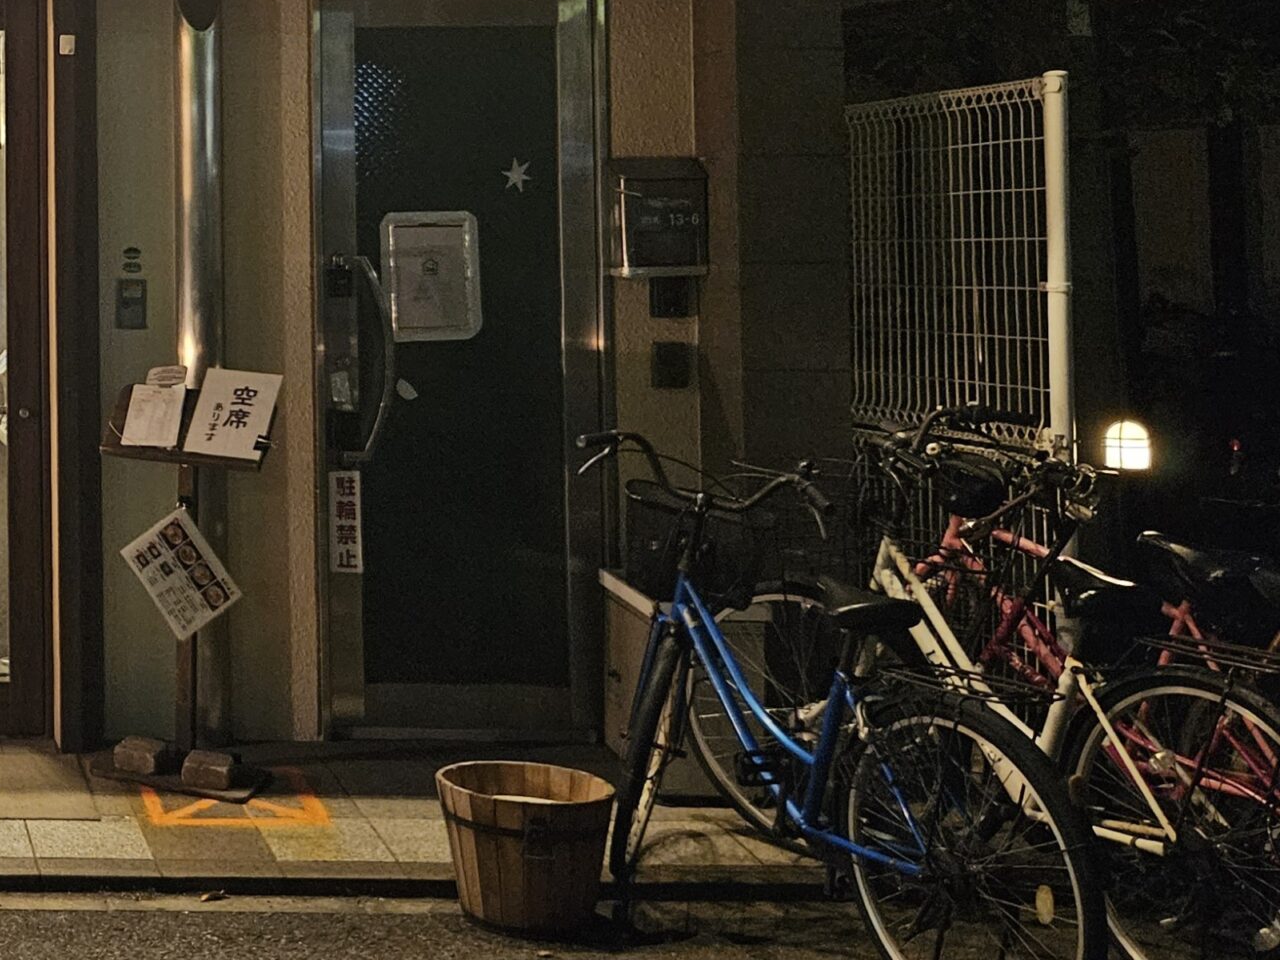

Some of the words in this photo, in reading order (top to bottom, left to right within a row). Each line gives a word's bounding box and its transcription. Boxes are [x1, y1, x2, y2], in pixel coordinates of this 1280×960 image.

[204, 402, 222, 441] あります
[222, 386, 258, 430] 空席
[335, 476, 358, 570] 駐輪禁止
